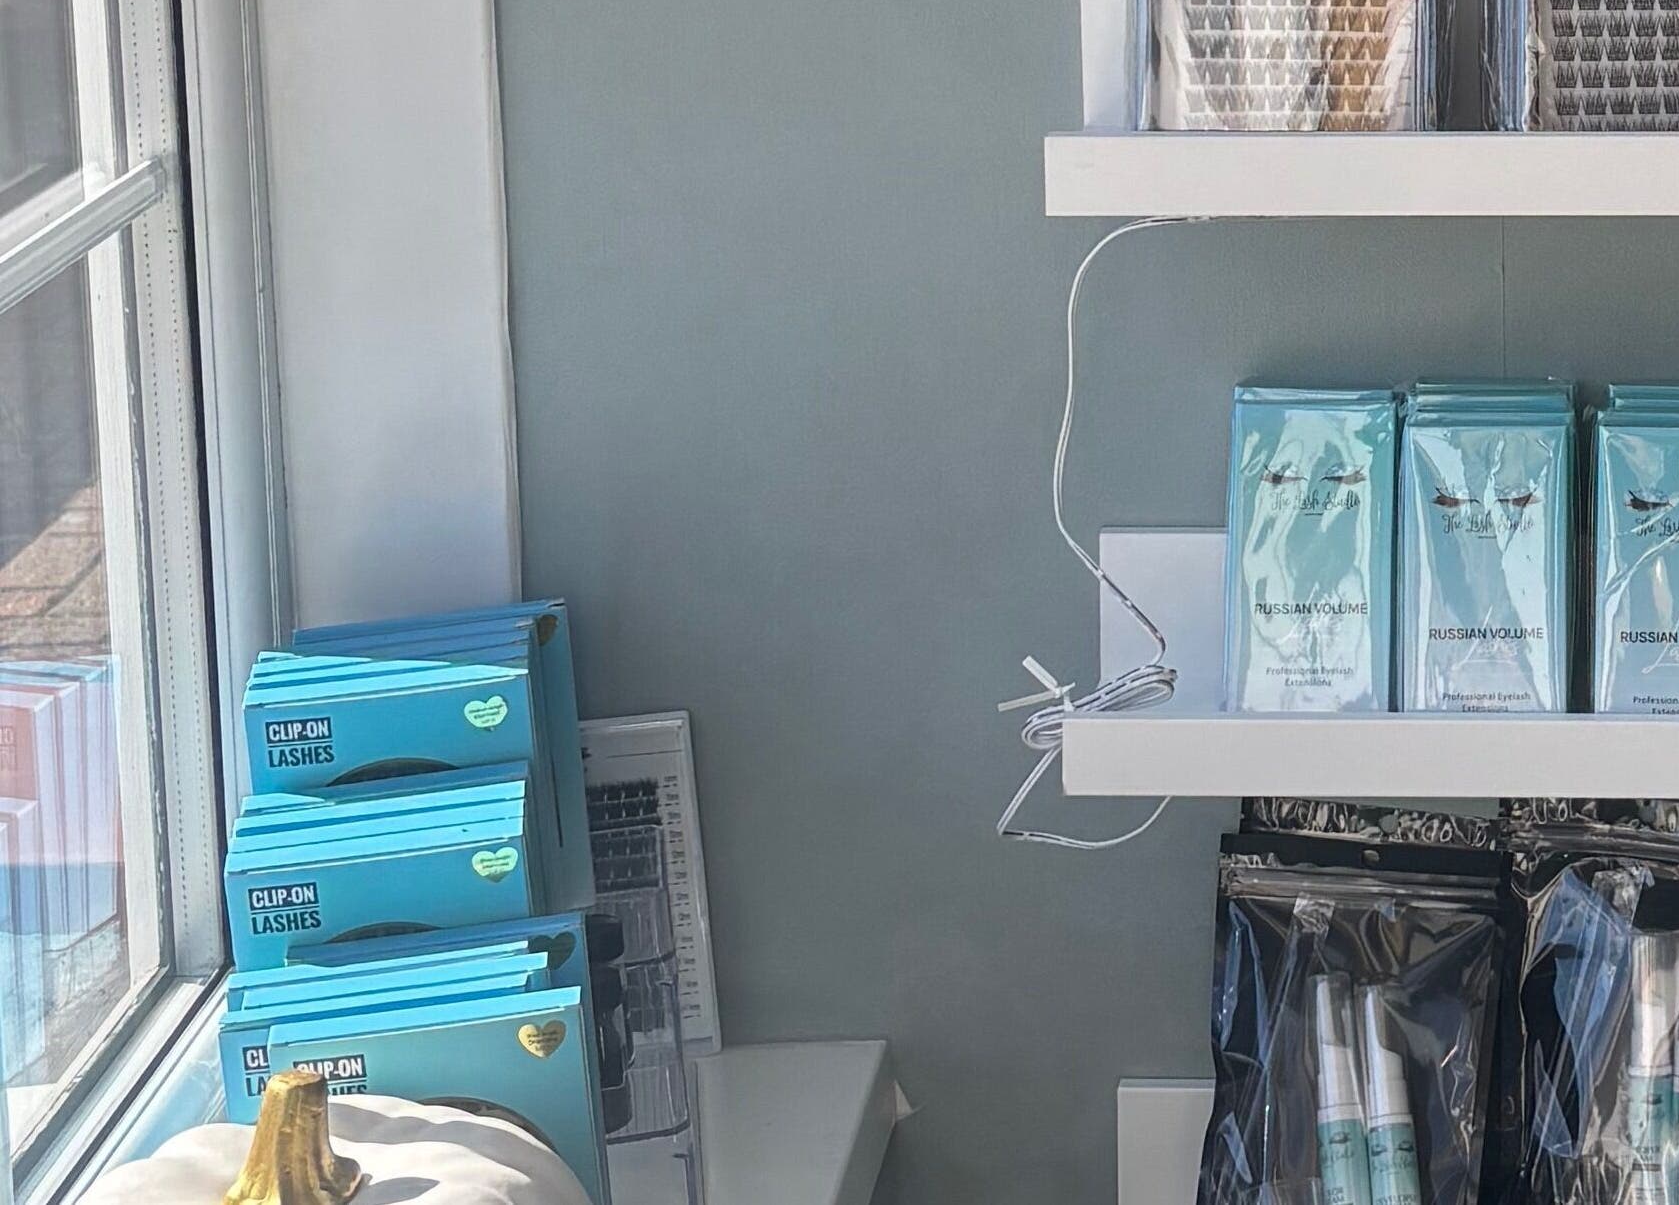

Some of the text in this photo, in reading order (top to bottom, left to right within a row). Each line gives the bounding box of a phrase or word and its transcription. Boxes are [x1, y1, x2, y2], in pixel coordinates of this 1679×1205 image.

[1254, 602, 1368, 615] RUSSIAN VOLUME
[1429, 627, 1544, 640] RUSSIAN VOLUME
[1620, 631, 1678, 644] RUSSIAN
[1443, 692, 1531, 702] Professional Eyelash
[268, 719, 330, 742] CLIP-ON
[268, 745, 335, 768] LASHES
[251, 885, 316, 908] CLIP-ON
[251, 910, 321, 935] LASHES
